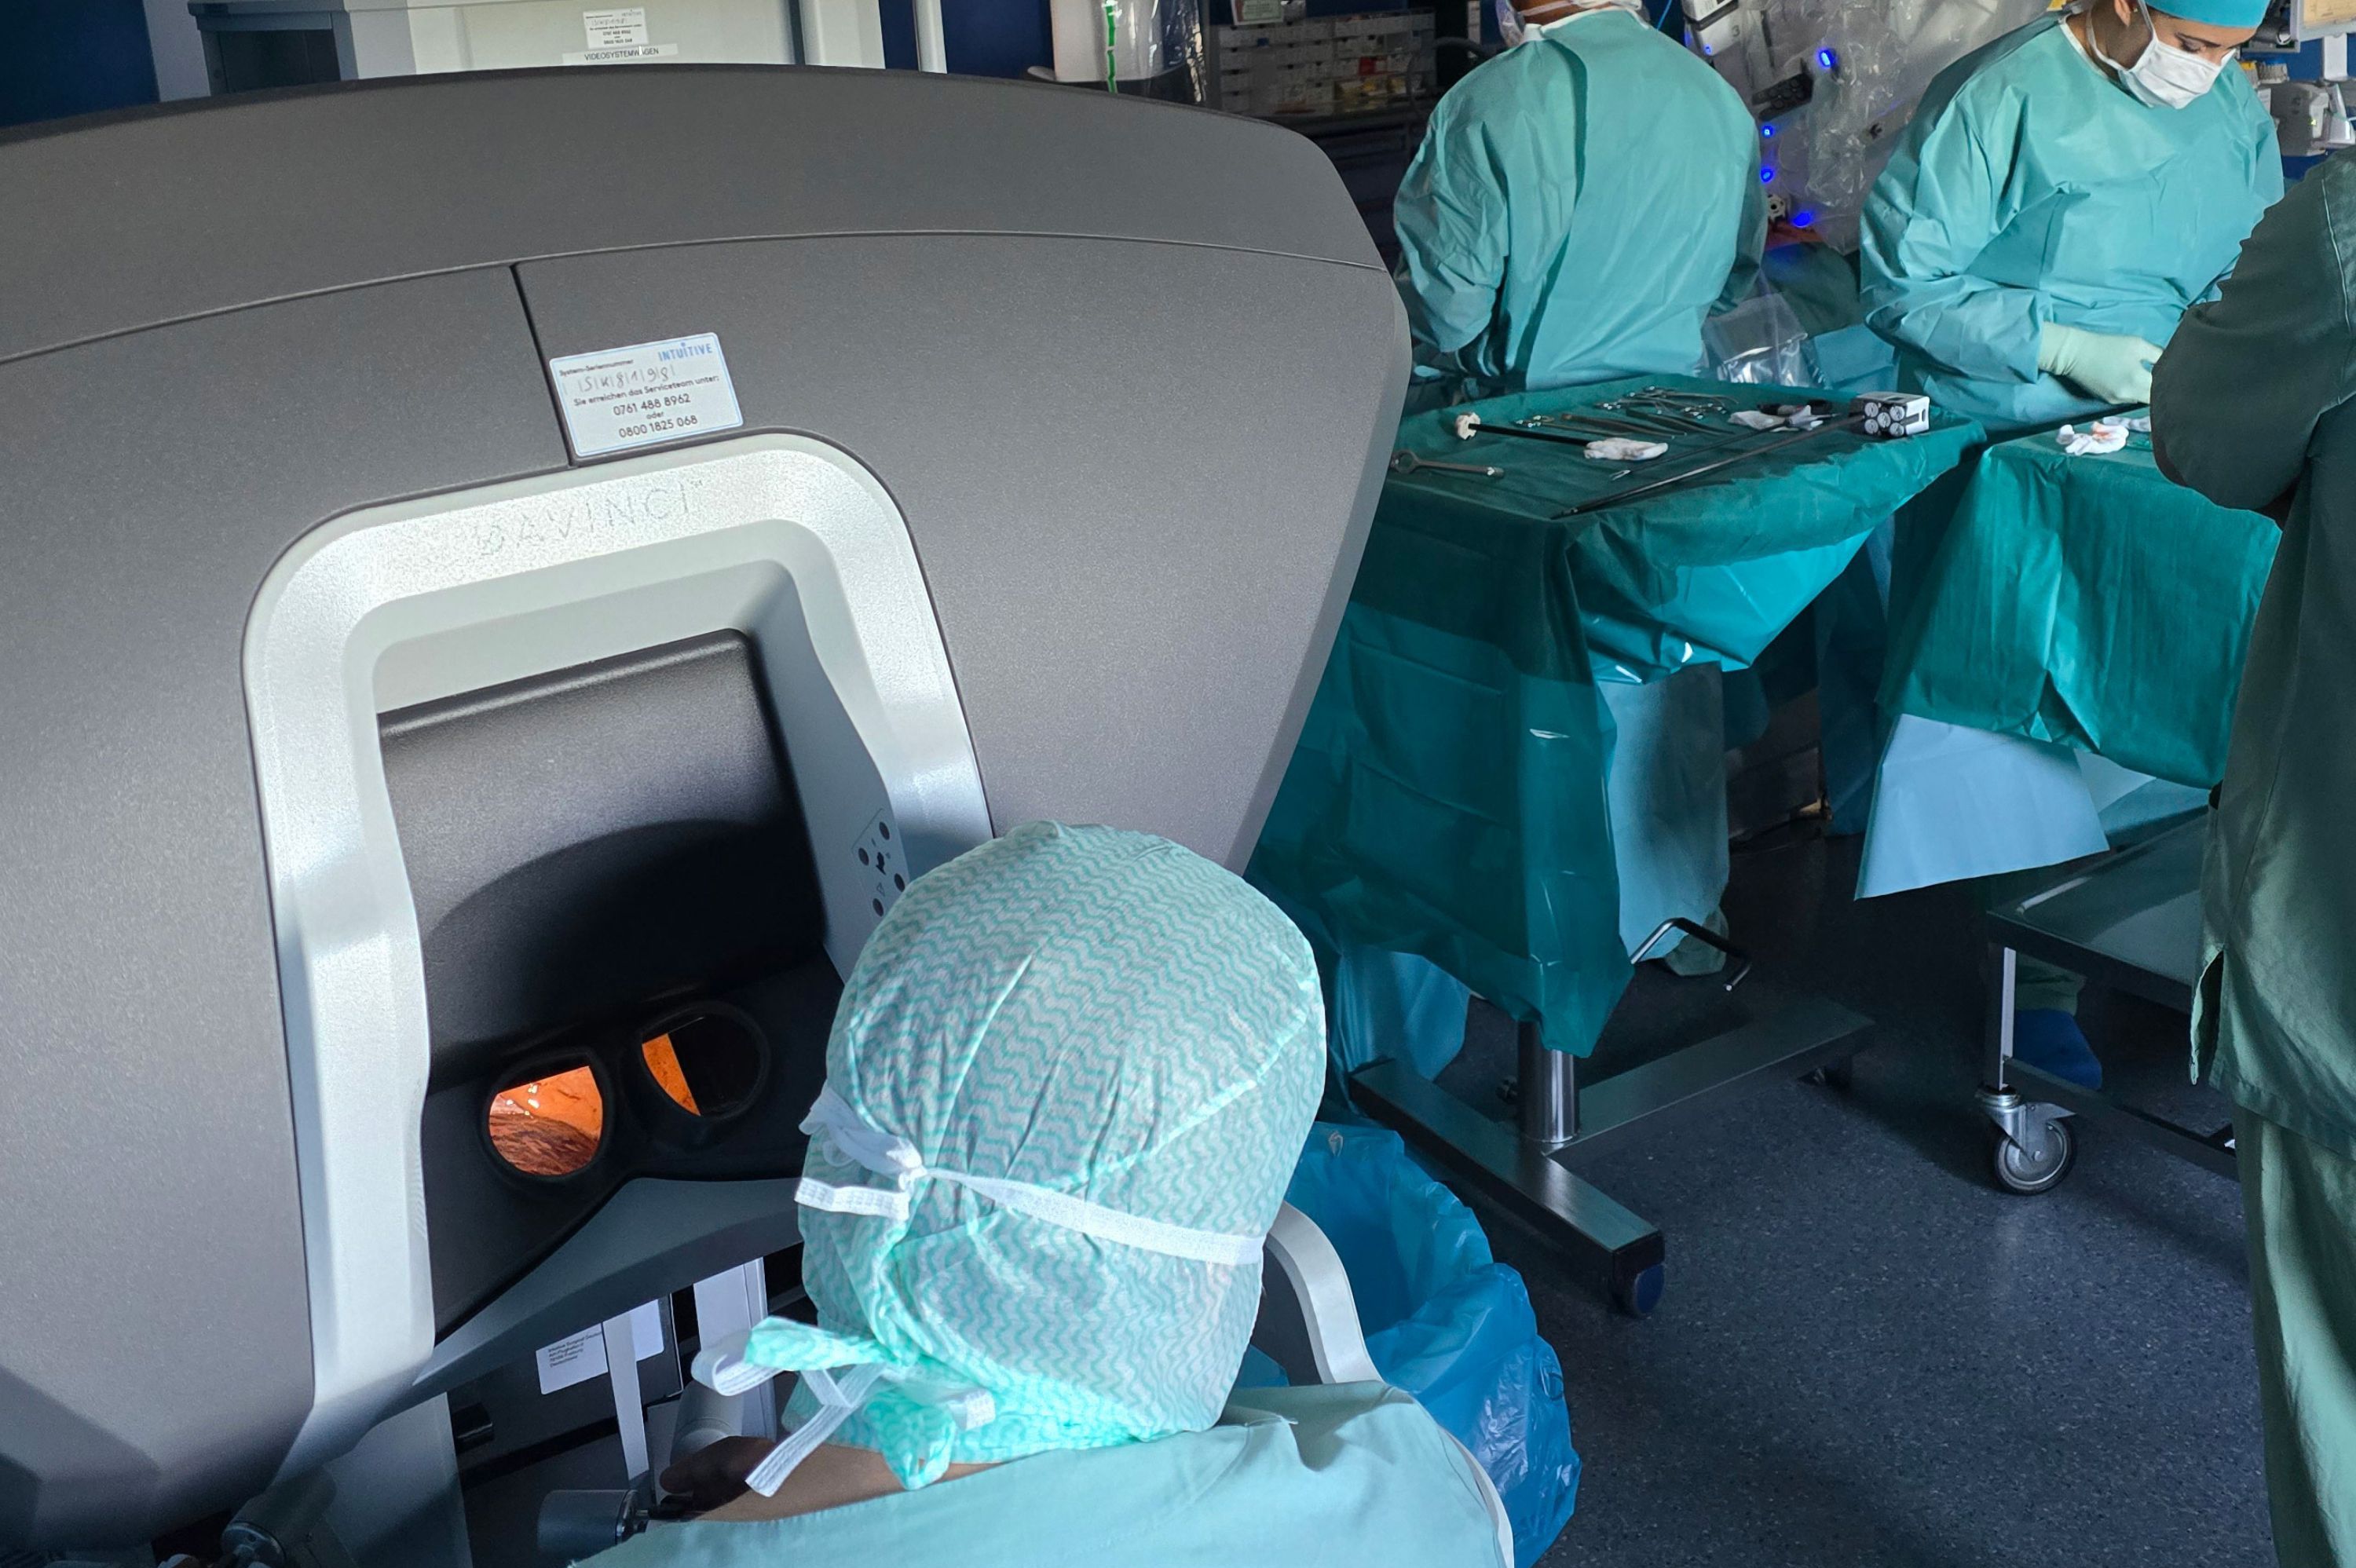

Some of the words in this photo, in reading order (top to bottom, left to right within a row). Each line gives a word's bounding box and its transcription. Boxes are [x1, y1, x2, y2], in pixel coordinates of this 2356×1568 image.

[1732, 25, 1740, 37] 3
[658, 342, 713, 361] INTUITIVE
[573, 397, 587, 407] Sie
[588, 392, 627, 404] erreichen
[644, 380, 694, 393] Serviceteam
[694, 375, 720, 385] unter:
[613, 402, 638, 416] 0761
[641, 398, 662, 411] 488
[664, 393, 691, 407] 8962
[646, 411, 664, 420] oder
[618, 423, 648, 438] 0800
[649, 418, 675, 433] 1825
[676, 415, 698, 427] 068
